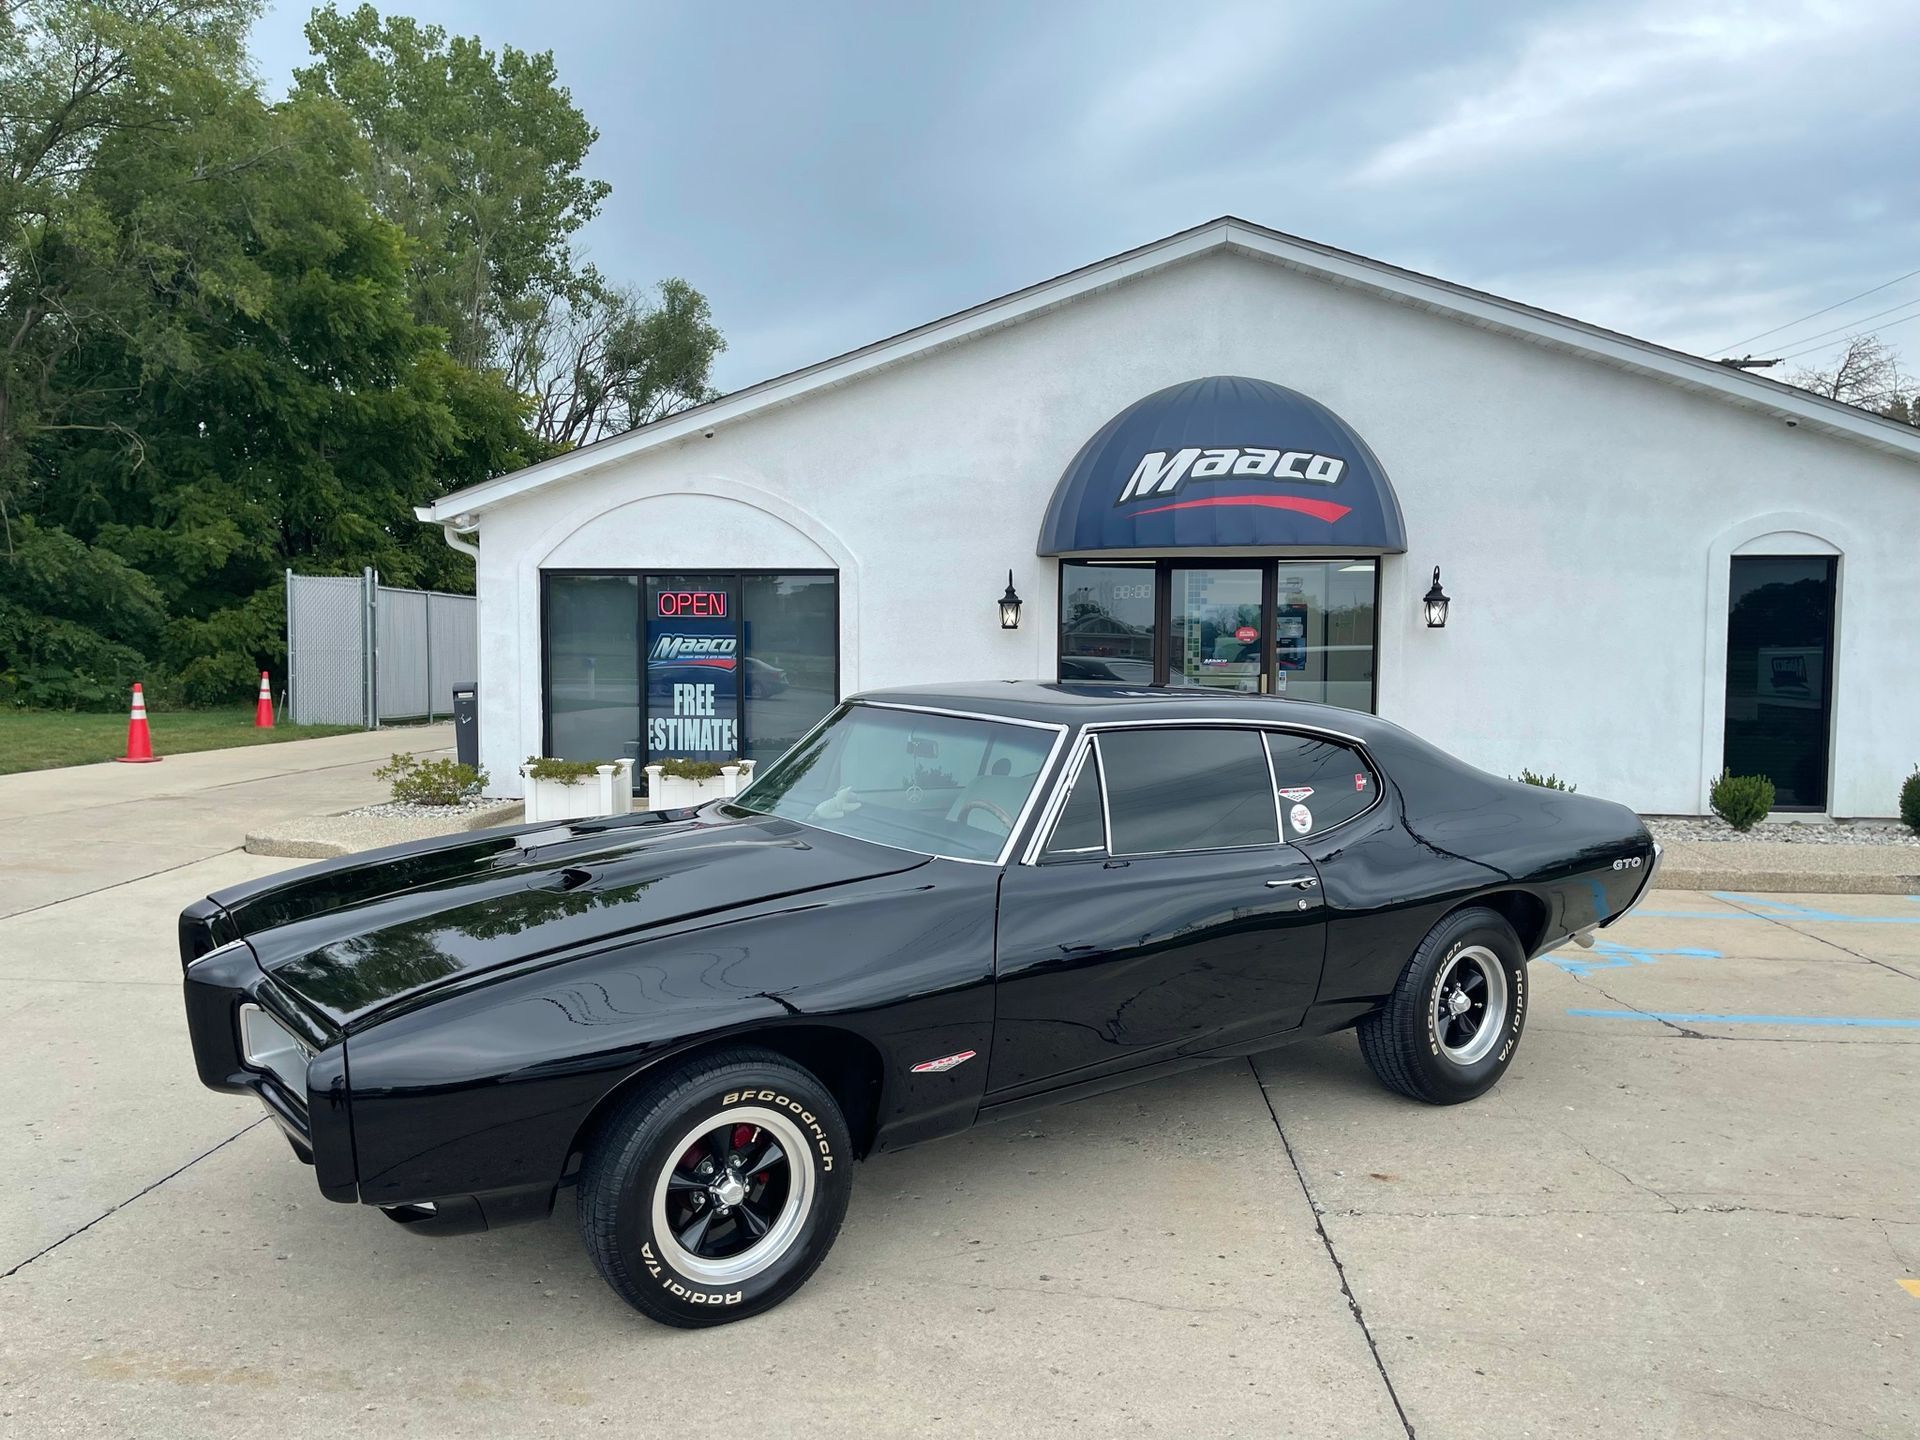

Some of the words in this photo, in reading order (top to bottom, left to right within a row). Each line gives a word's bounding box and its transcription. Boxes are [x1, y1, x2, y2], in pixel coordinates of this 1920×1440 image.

[1118, 447, 1345, 503] Maaco
[659, 593, 725, 616] OPEN
[653, 637, 737, 658] Maaco
[673, 683, 715, 716] FREE
[1612, 856, 1641, 871] GTO
[1427, 941, 1462, 1056] BFGoodrich
[1513, 969, 1525, 1033] Radial
[722, 1090, 832, 1172] BFGoodrich
[641, 1241, 662, 1279] T/A
[662, 1278, 742, 1305] Radial
